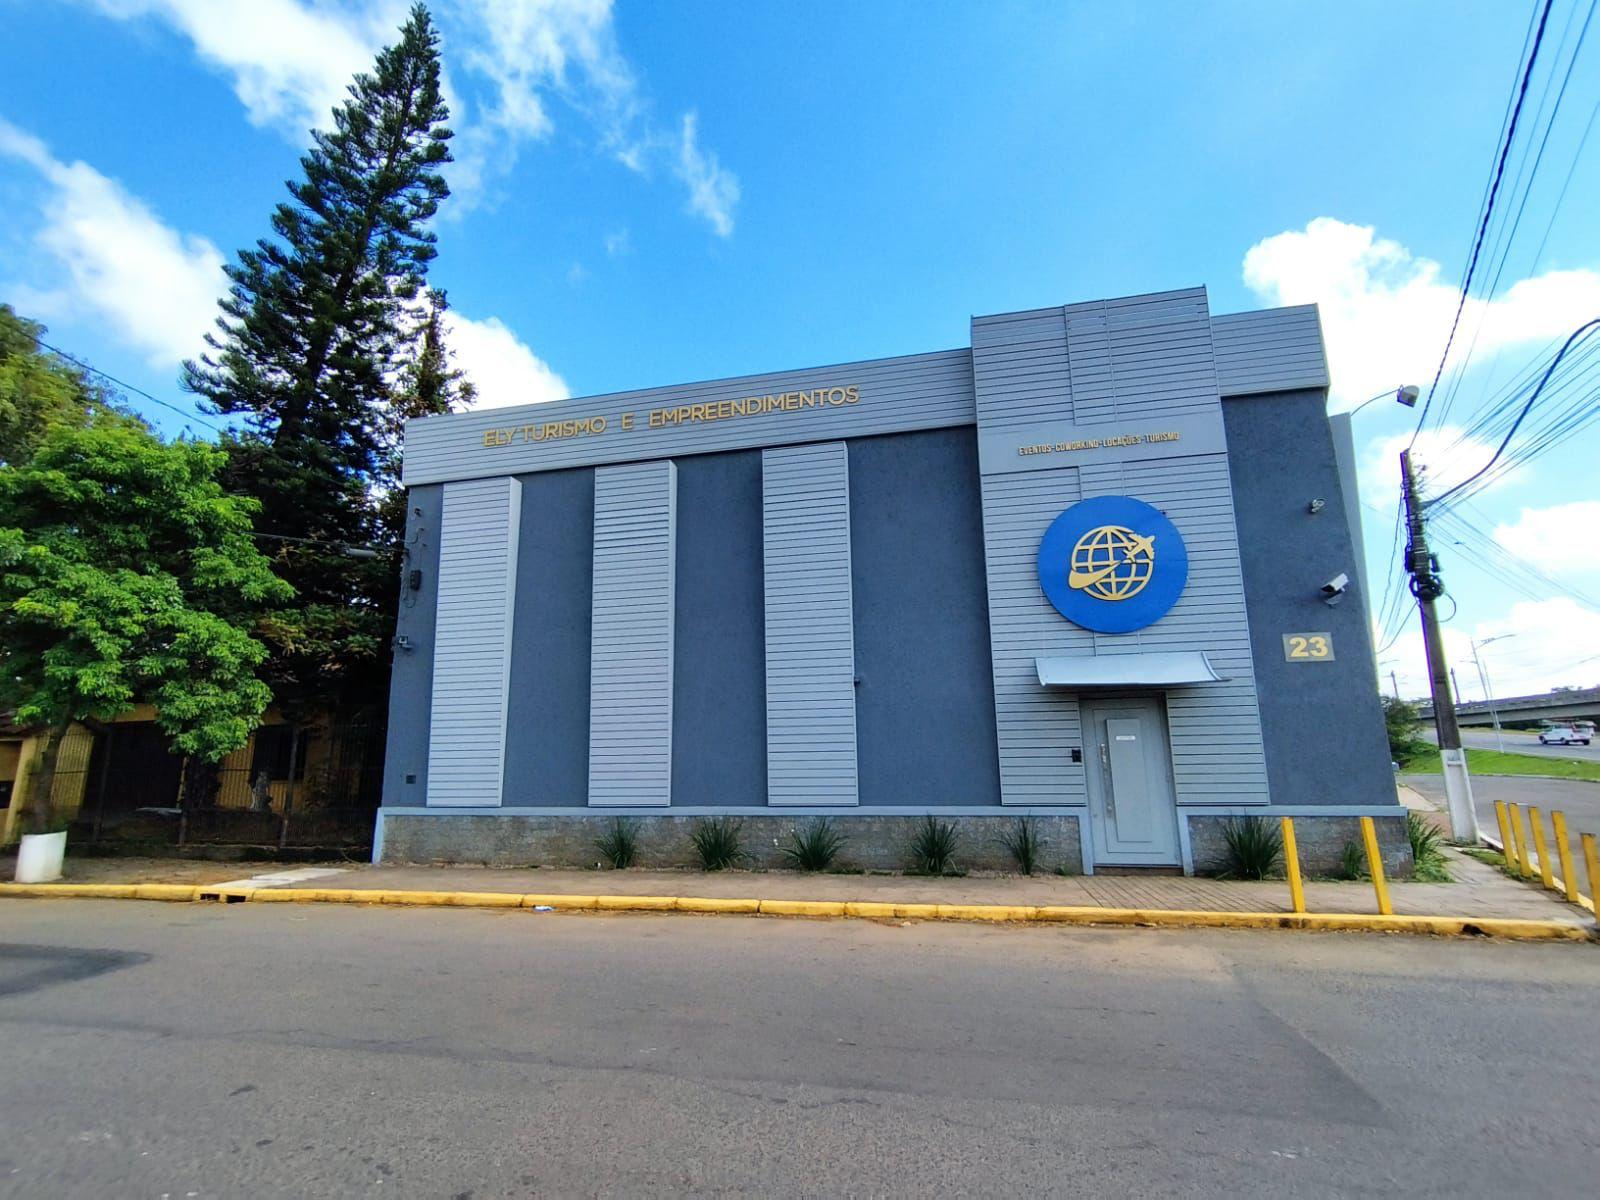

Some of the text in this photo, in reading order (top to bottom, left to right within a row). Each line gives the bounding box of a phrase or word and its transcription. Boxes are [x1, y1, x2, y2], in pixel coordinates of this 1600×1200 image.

[483, 384, 860, 447] ELY TURISMO E EMPREENDIMENTOS
[1290, 636, 1329, 657] 23
